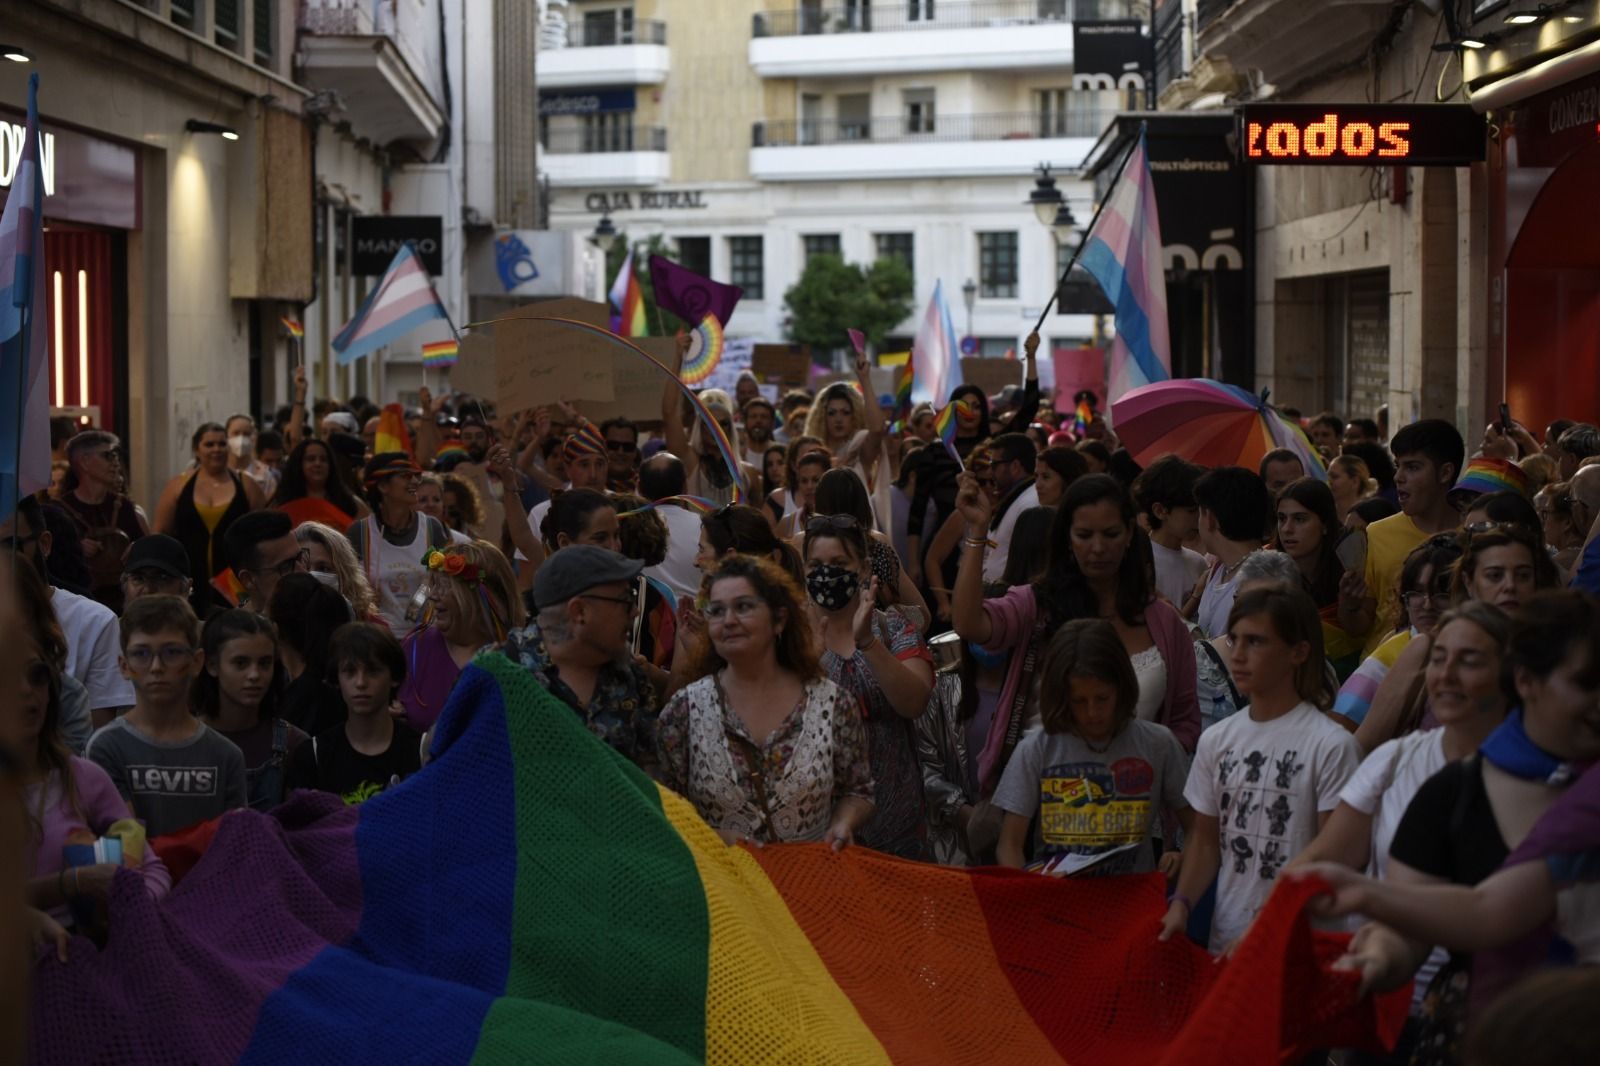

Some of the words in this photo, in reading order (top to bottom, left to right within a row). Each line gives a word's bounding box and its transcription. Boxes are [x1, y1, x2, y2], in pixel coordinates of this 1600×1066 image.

[585, 192, 633, 213] CAJA
[639, 191, 707, 209] RURAL
[357, 237, 437, 254] MANO
